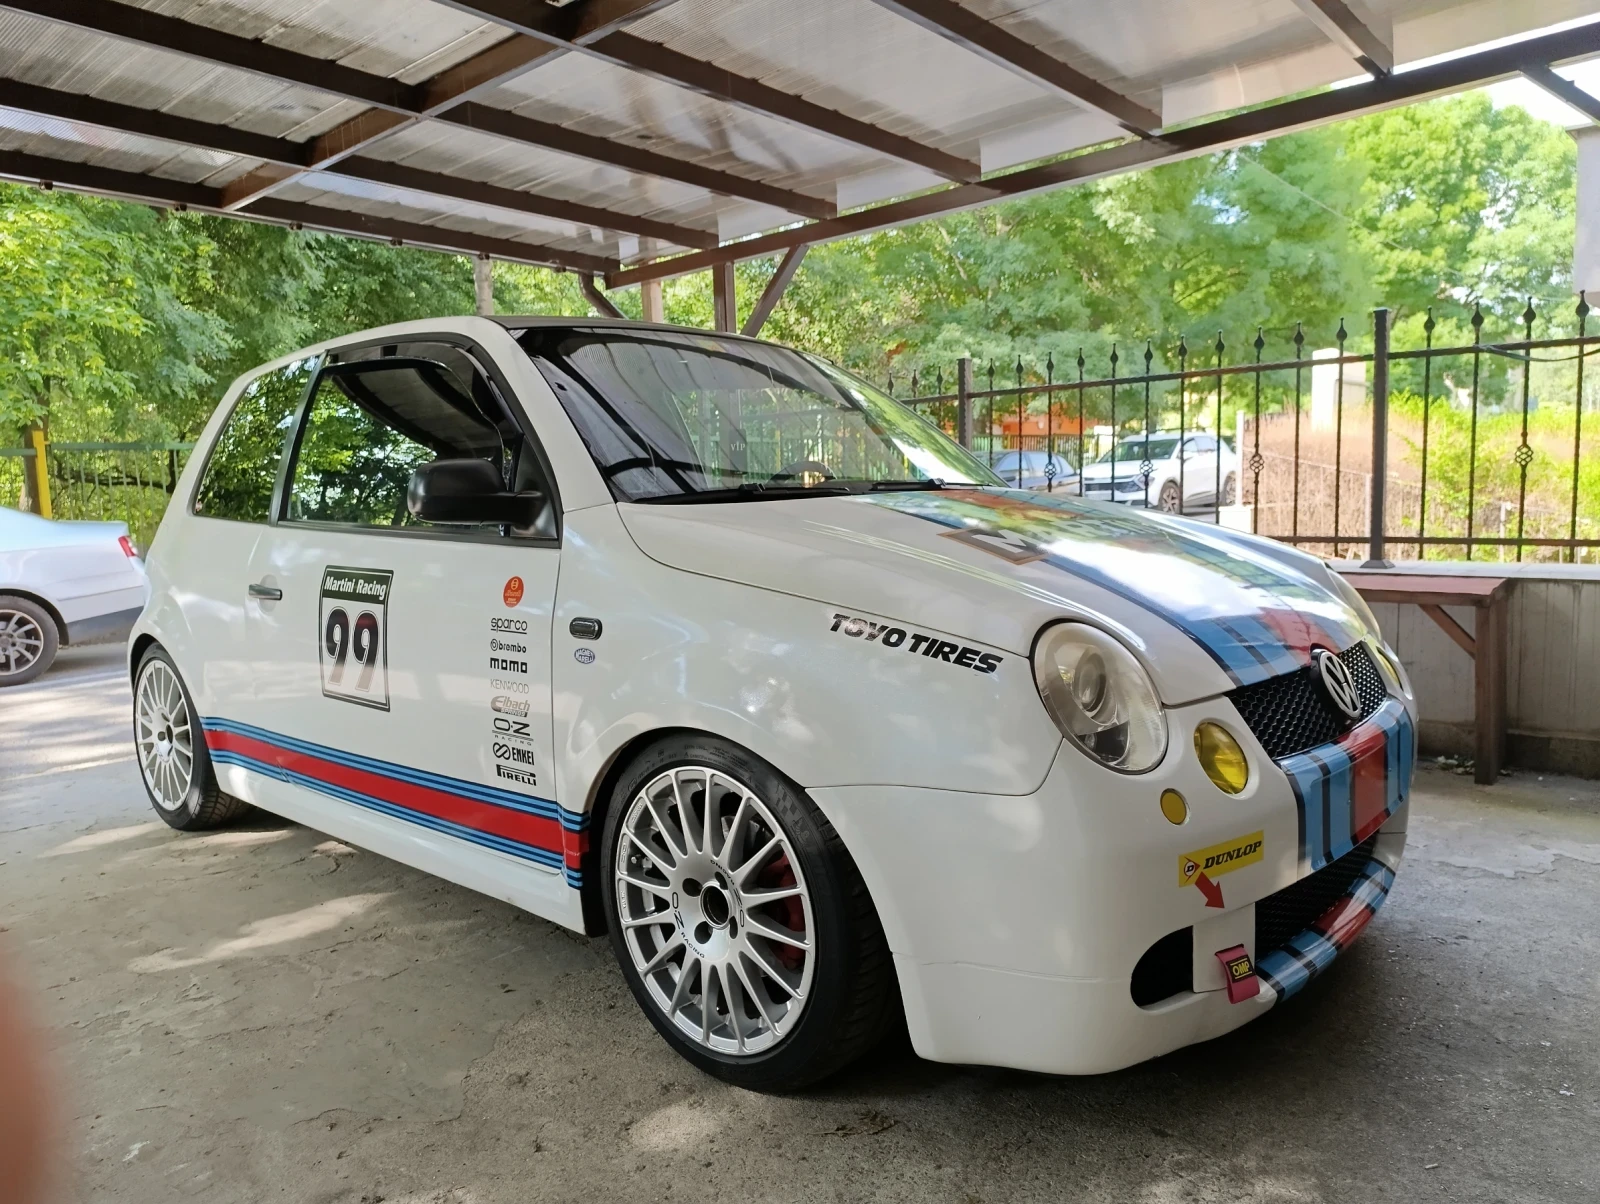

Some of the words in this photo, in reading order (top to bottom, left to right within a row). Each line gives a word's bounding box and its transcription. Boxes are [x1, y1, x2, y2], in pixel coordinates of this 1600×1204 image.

[730, 441, 746, 451] VIP
[324, 576, 355, 593] Martini
[356, 579, 387, 600] Racing
[490, 617, 528, 632] sparco
[325, 606, 379, 692] 99
[498, 640, 527, 653] brembo
[830, 613, 907, 648] TOYO
[908, 633, 1004, 674] TIRES
[490, 679, 530, 694] KENWOOD
[494, 734, 532, 746] RACING
[511, 747, 535, 766] ENKEI
[496, 764, 537, 786] PIRELLI
[1203, 840, 1262, 870] DUNLOP
[1232, 961, 1251, 976] OMP
